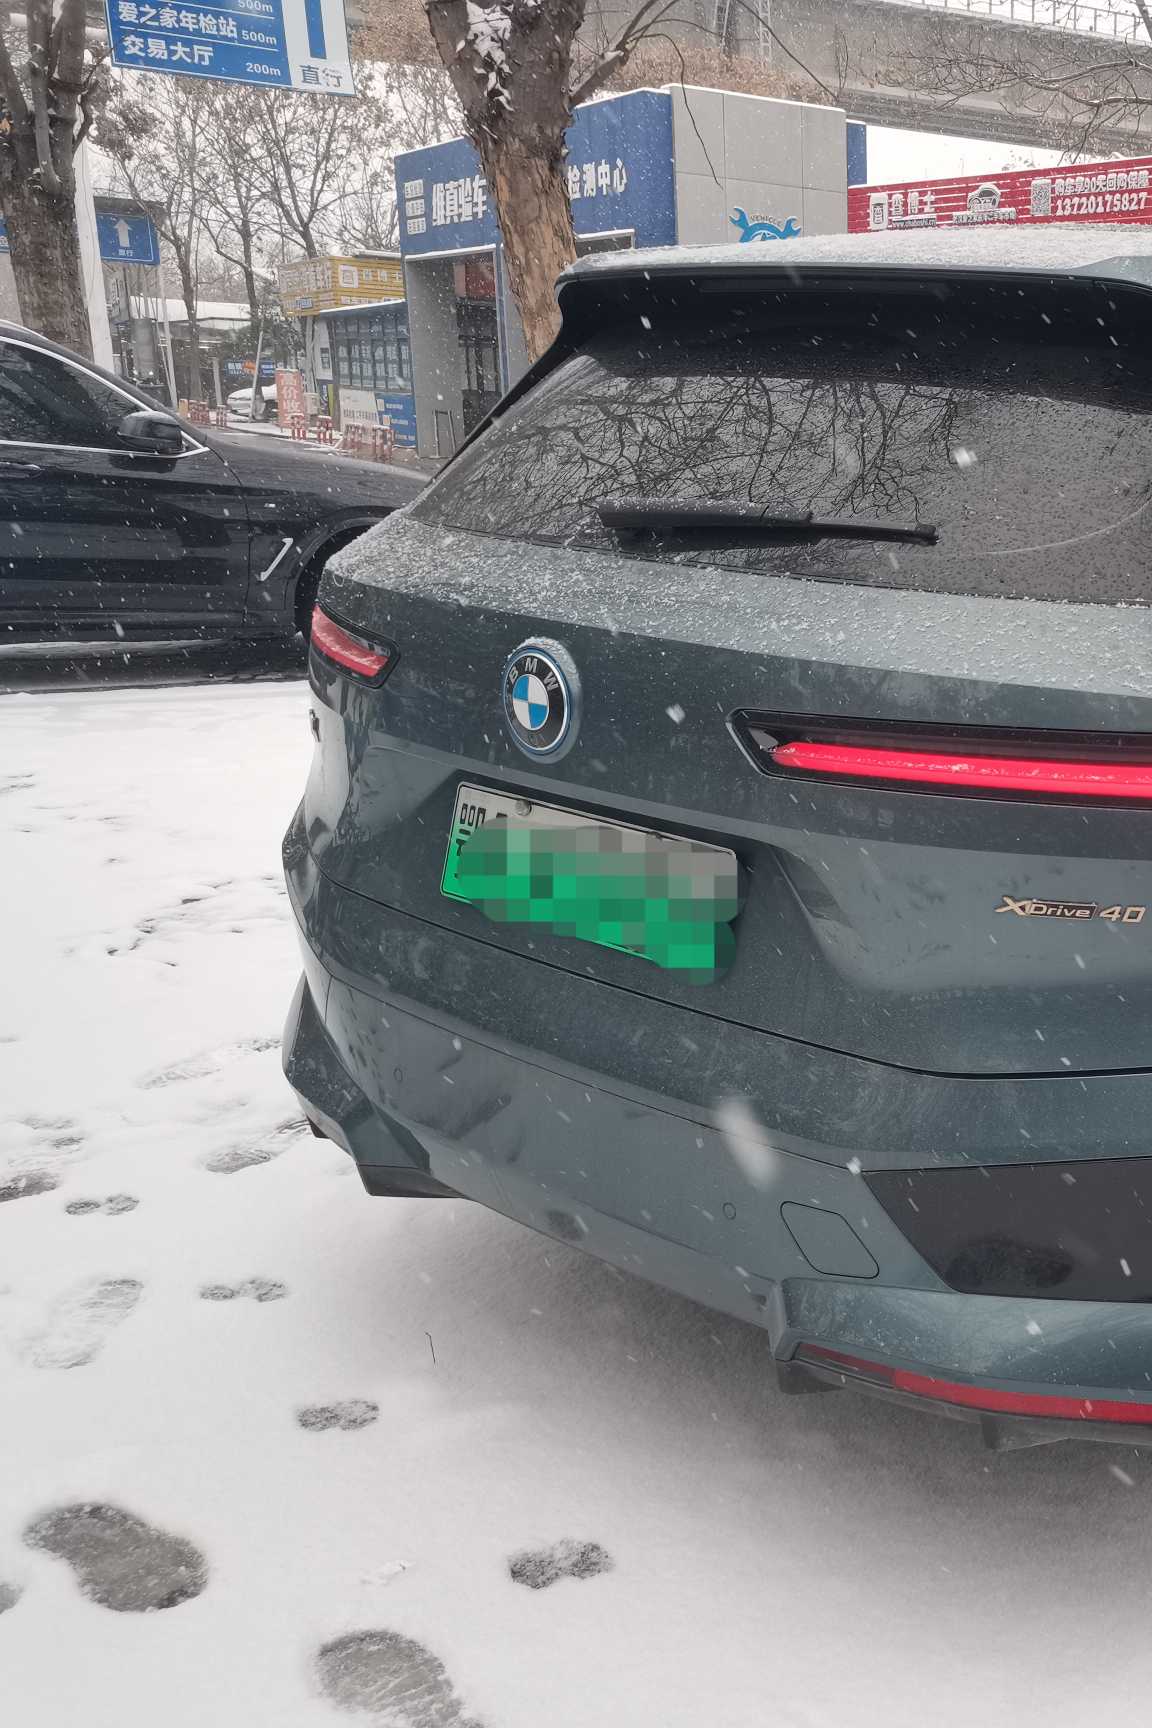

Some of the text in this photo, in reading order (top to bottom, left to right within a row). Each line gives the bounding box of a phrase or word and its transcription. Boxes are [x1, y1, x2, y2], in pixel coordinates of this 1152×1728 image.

[118, 1, 277, 46] 爱之家年检站 500m
[122, 34, 281, 77] 交易大厅 200m
[300, 64, 343, 88] 直行
[568, 157, 627, 201] 检测中心
[1055, 192, 1148, 216] 13720175827
[509, 656, 559, 692] BMW
[1100, 905, 1147, 924] 40
